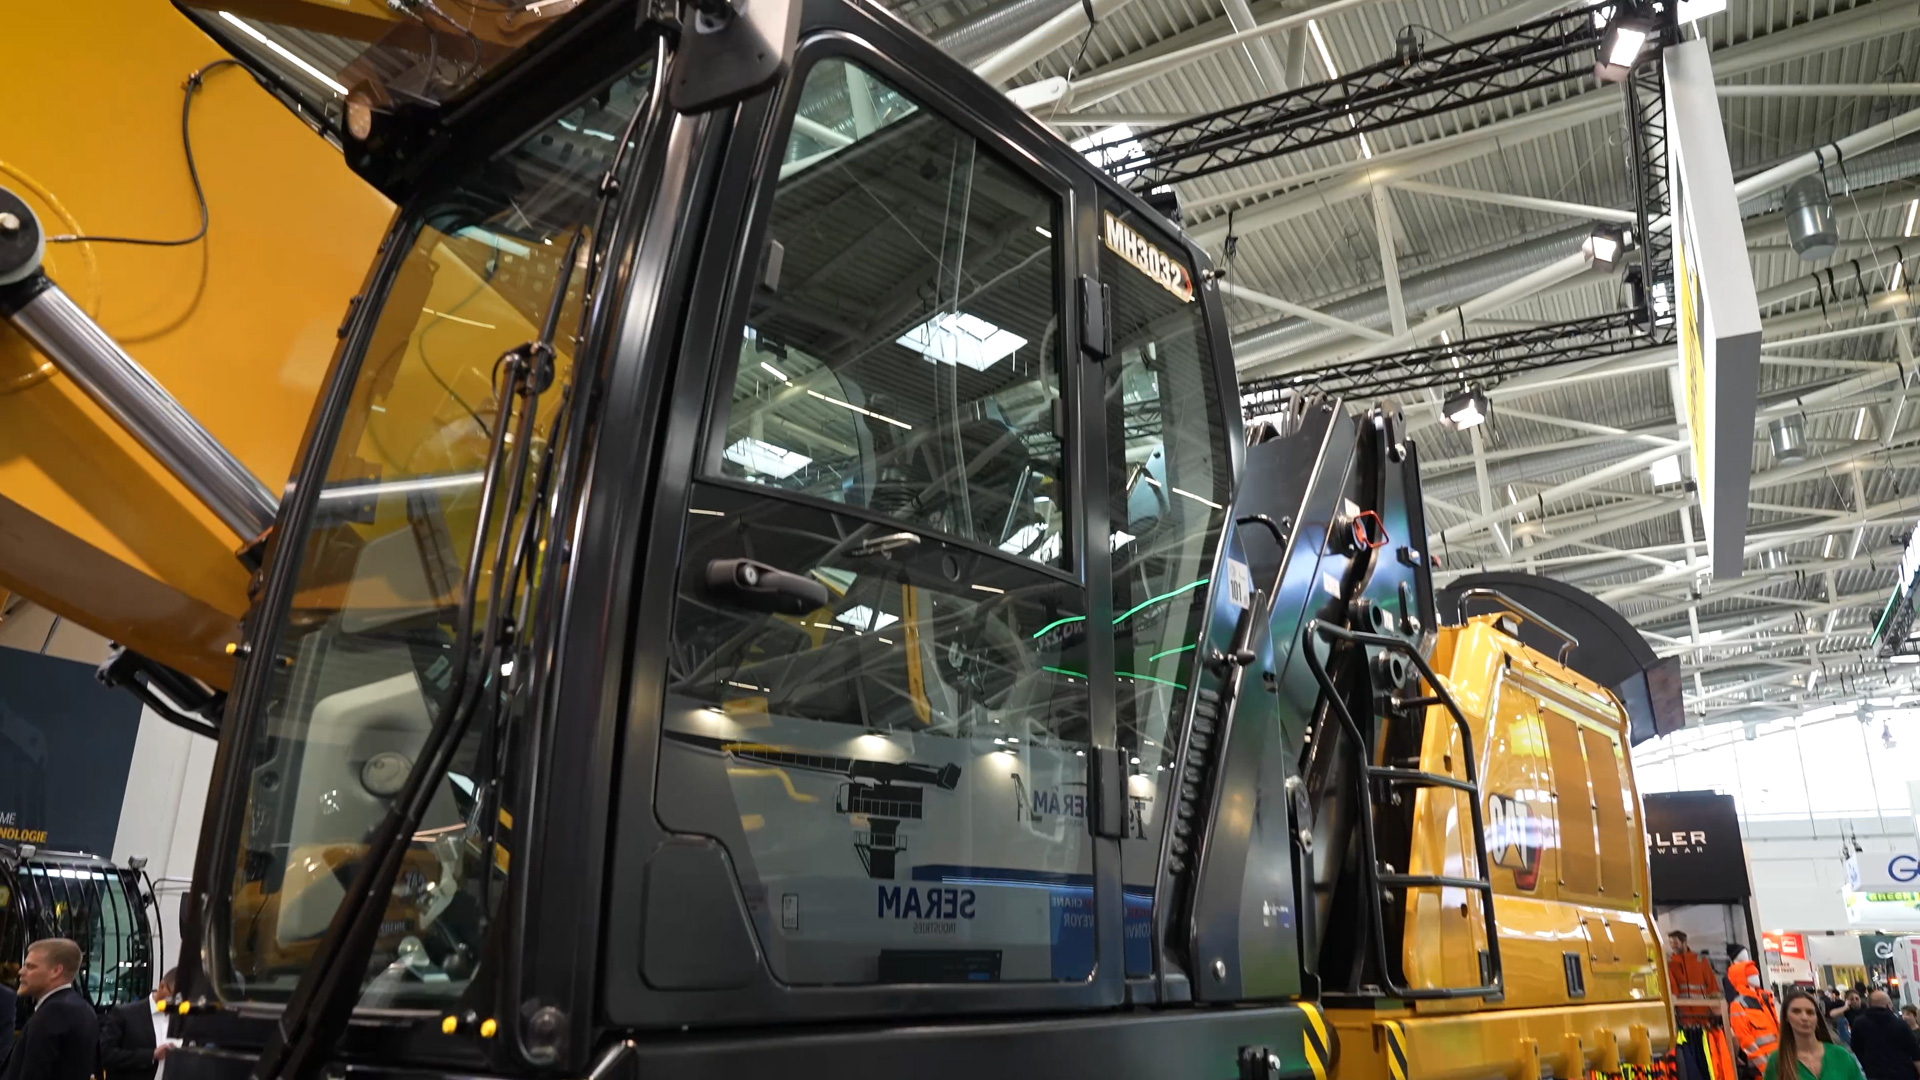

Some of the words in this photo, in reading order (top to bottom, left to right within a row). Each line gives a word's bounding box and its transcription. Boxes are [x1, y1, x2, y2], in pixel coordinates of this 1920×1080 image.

[1106, 214, 1184, 293] MH3032
[1231, 579, 1242, 602] 101
[0, 827, 48, 843] NOLOGIE
[1490, 794, 1528, 870] CAT
[1888, 854, 1920, 882] G
